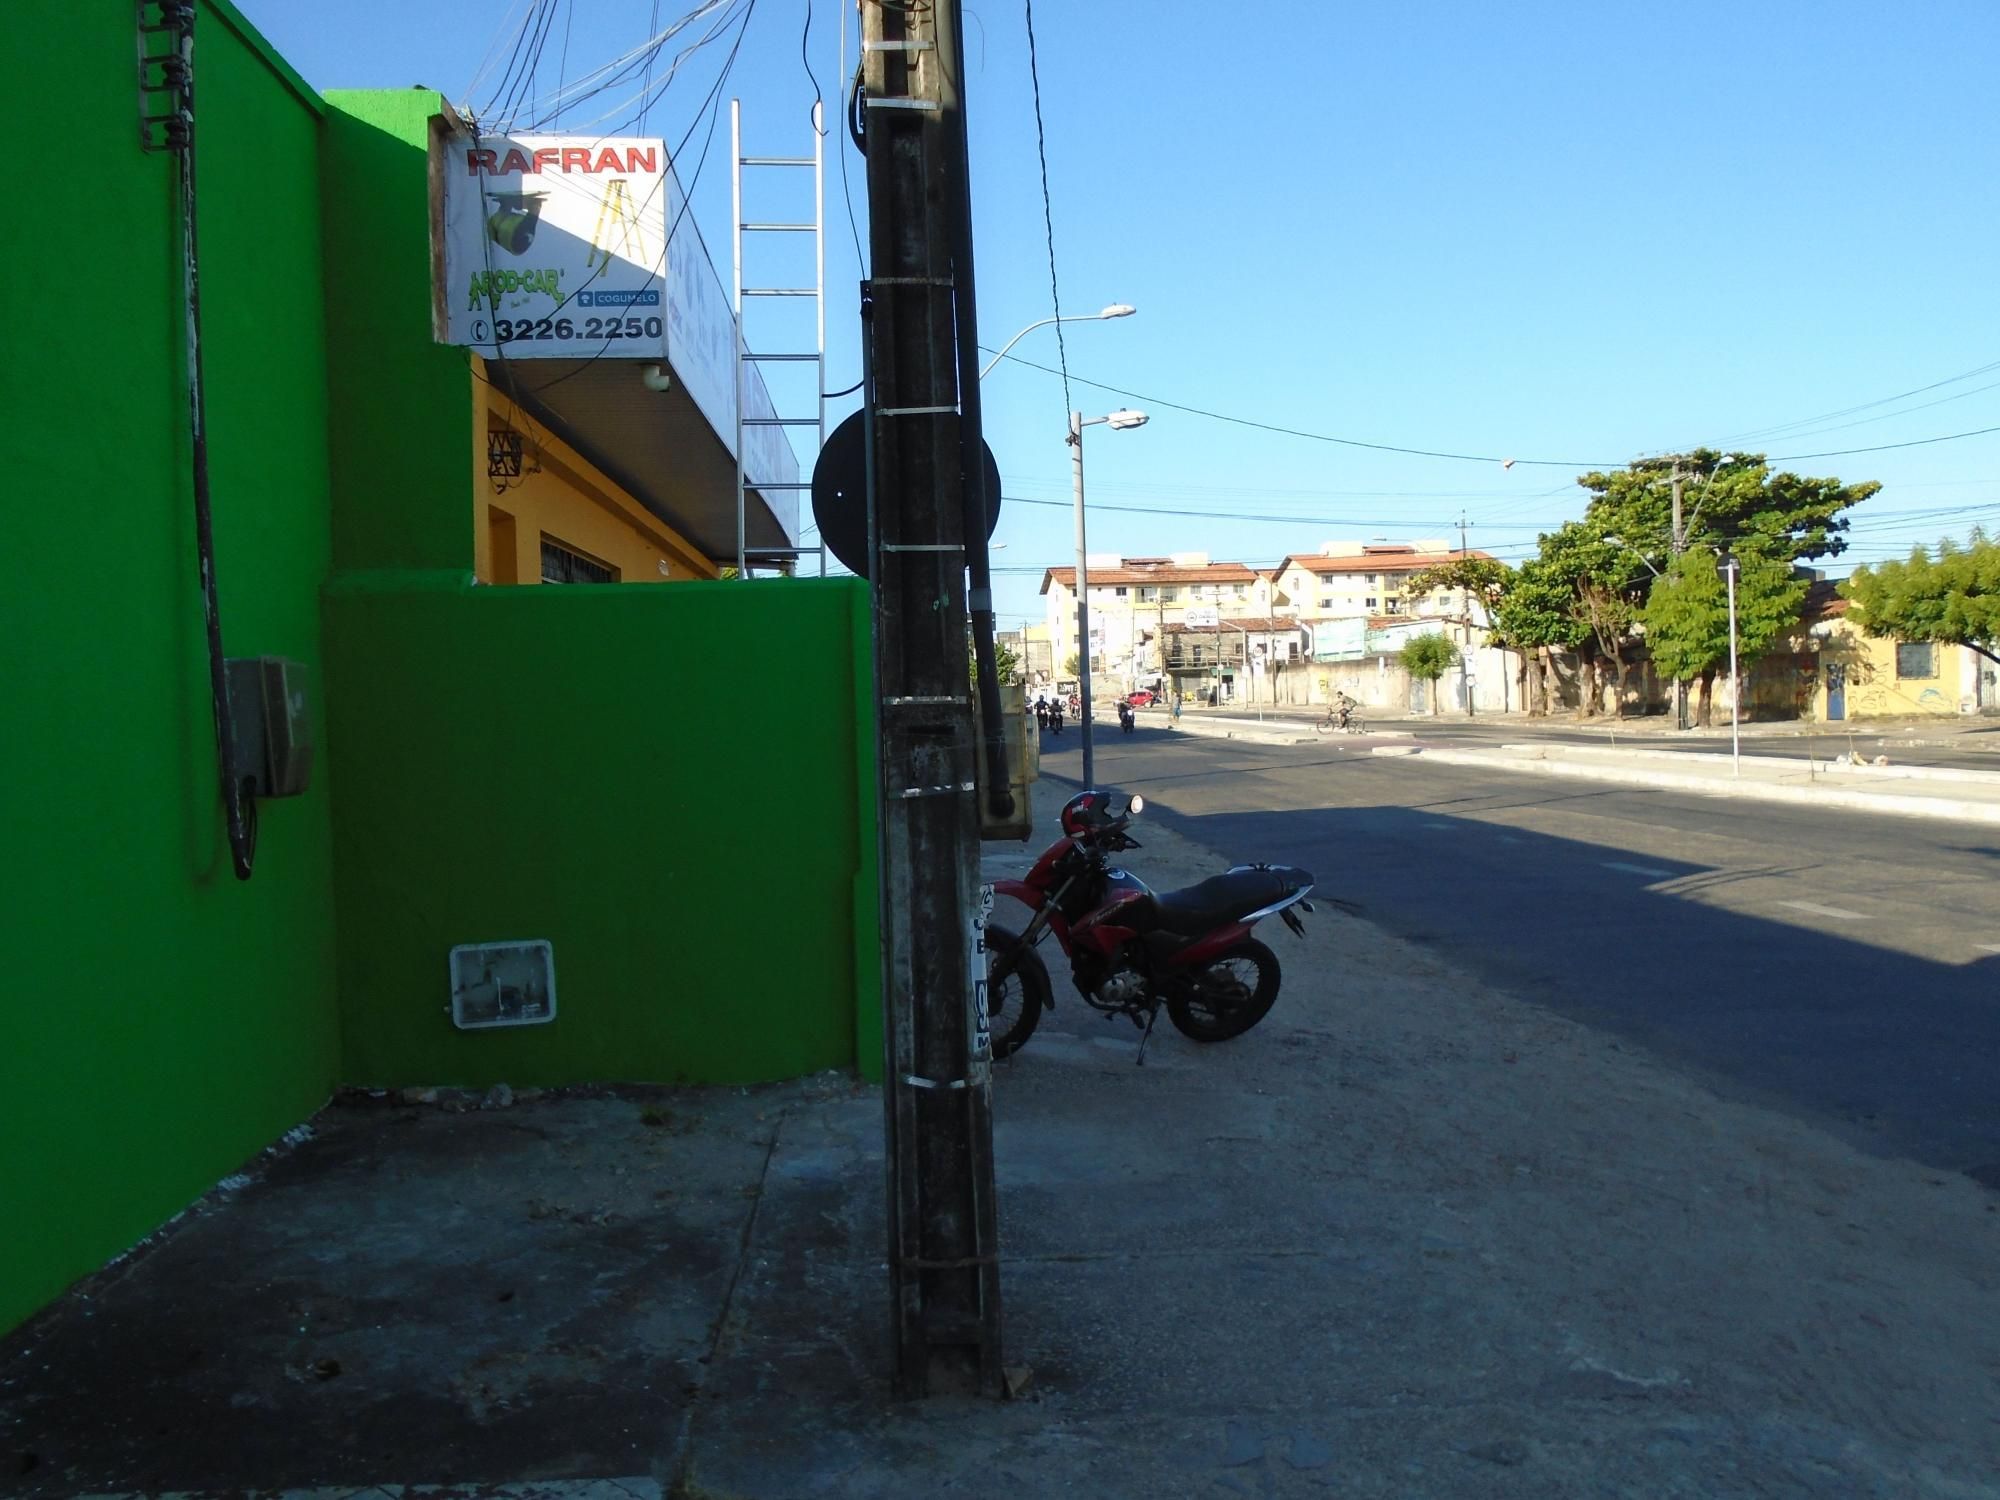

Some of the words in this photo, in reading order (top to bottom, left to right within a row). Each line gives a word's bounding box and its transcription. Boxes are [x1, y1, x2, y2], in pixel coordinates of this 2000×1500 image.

[467, 148, 656, 176] RAFRAN
[598, 294, 657, 303] COGUMELO
[497, 318, 663, 340] 3226.2250
